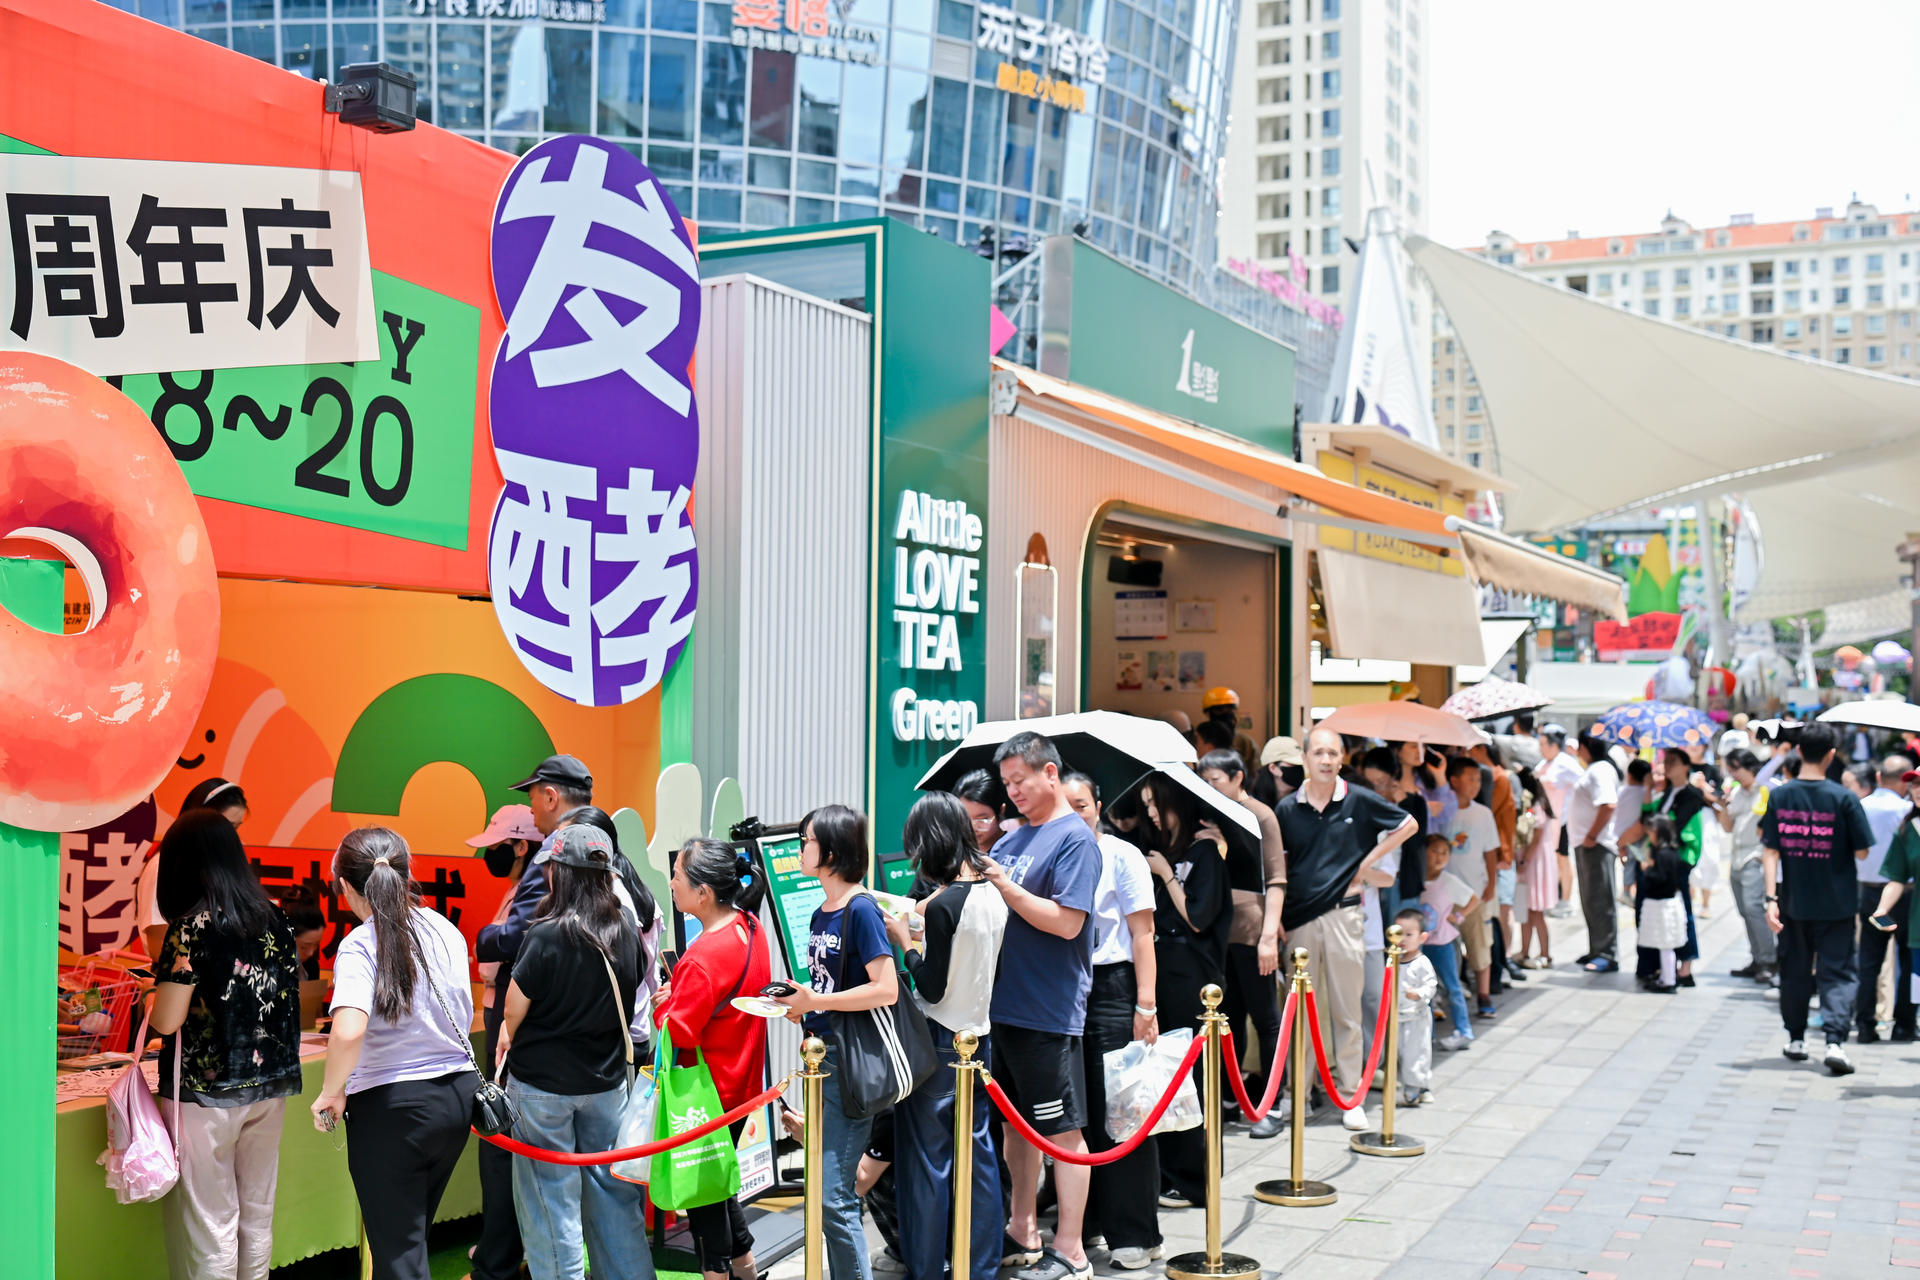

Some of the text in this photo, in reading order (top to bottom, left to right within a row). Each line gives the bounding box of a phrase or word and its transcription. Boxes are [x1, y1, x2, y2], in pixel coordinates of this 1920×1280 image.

[977, 2, 1110, 84] 茄子恰恰
[6, 193, 341, 341] 周年庆
[106, 366, 414, 507] 8~20
[494, 143, 700, 706] 发酵
[894, 546, 980, 613] LOVE
[893, 609, 963, 671] TEA
[890, 687, 977, 741] Green
[1778, 822, 1833, 836] Fancy box
